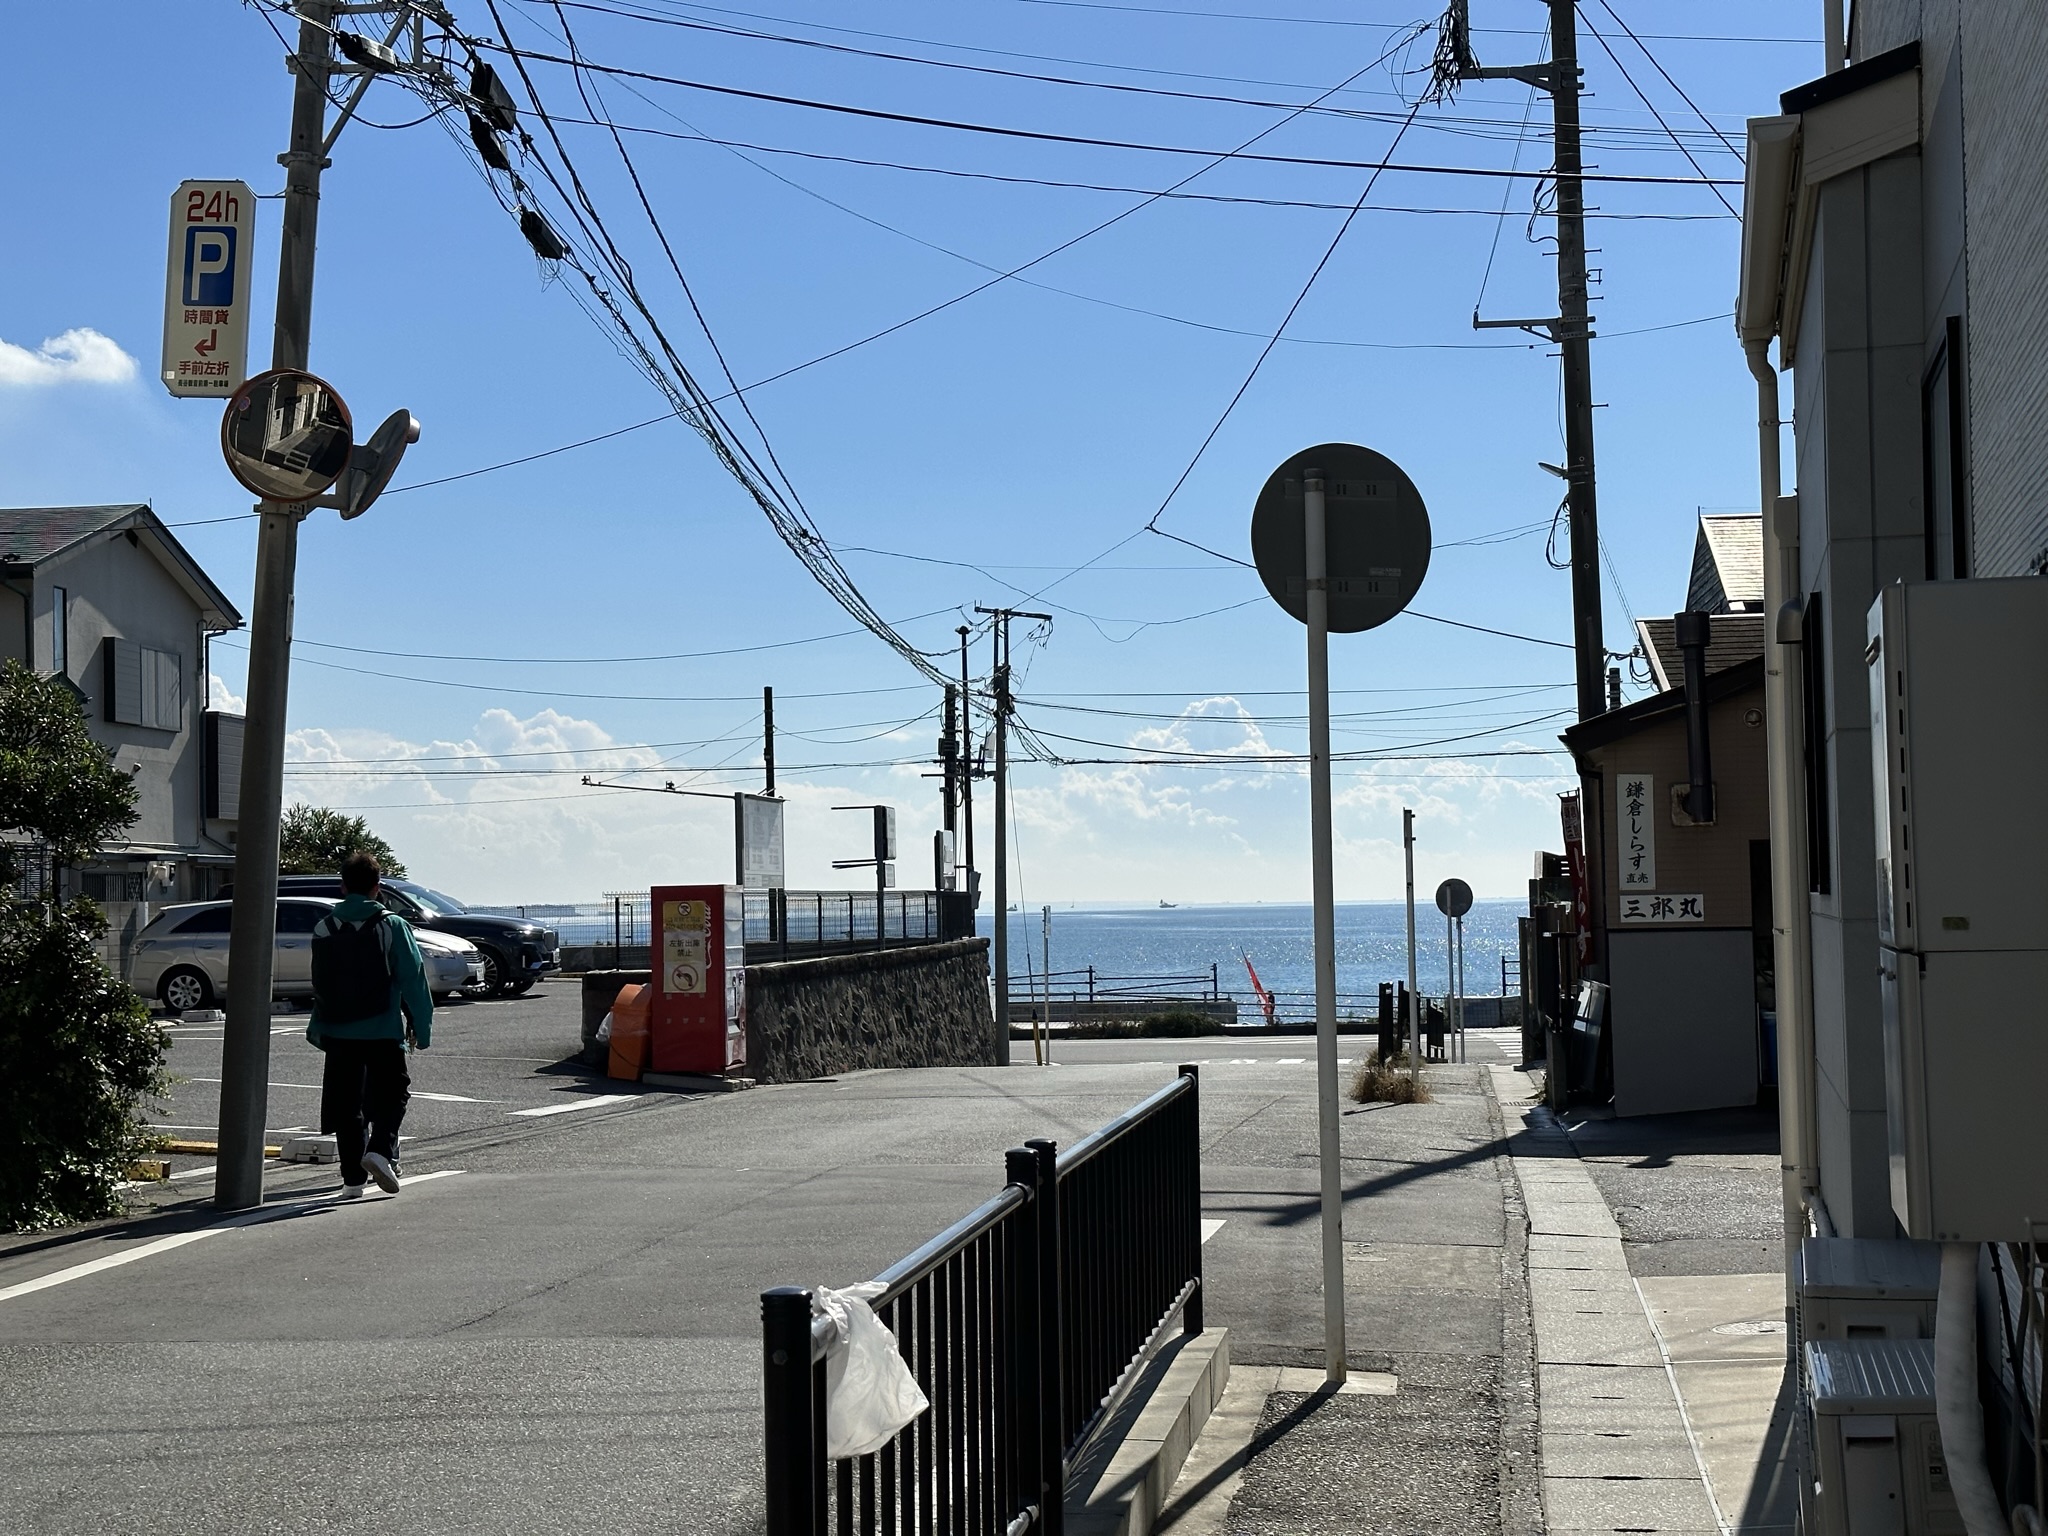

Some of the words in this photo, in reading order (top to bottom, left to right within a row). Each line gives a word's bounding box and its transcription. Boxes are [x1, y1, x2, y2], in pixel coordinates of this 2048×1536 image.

[186, 190, 239, 223] 24h
[190, 231, 230, 301] P
[184, 309, 230, 325] 時間貸
[178, 360, 230, 376] 手前左折
[1625, 780, 1646, 871] 鎌倉しらす
[1626, 872, 1649, 884] 直売
[1623, 896, 1703, 921] 三郎丸
[677, 949, 693, 957] 禁止
